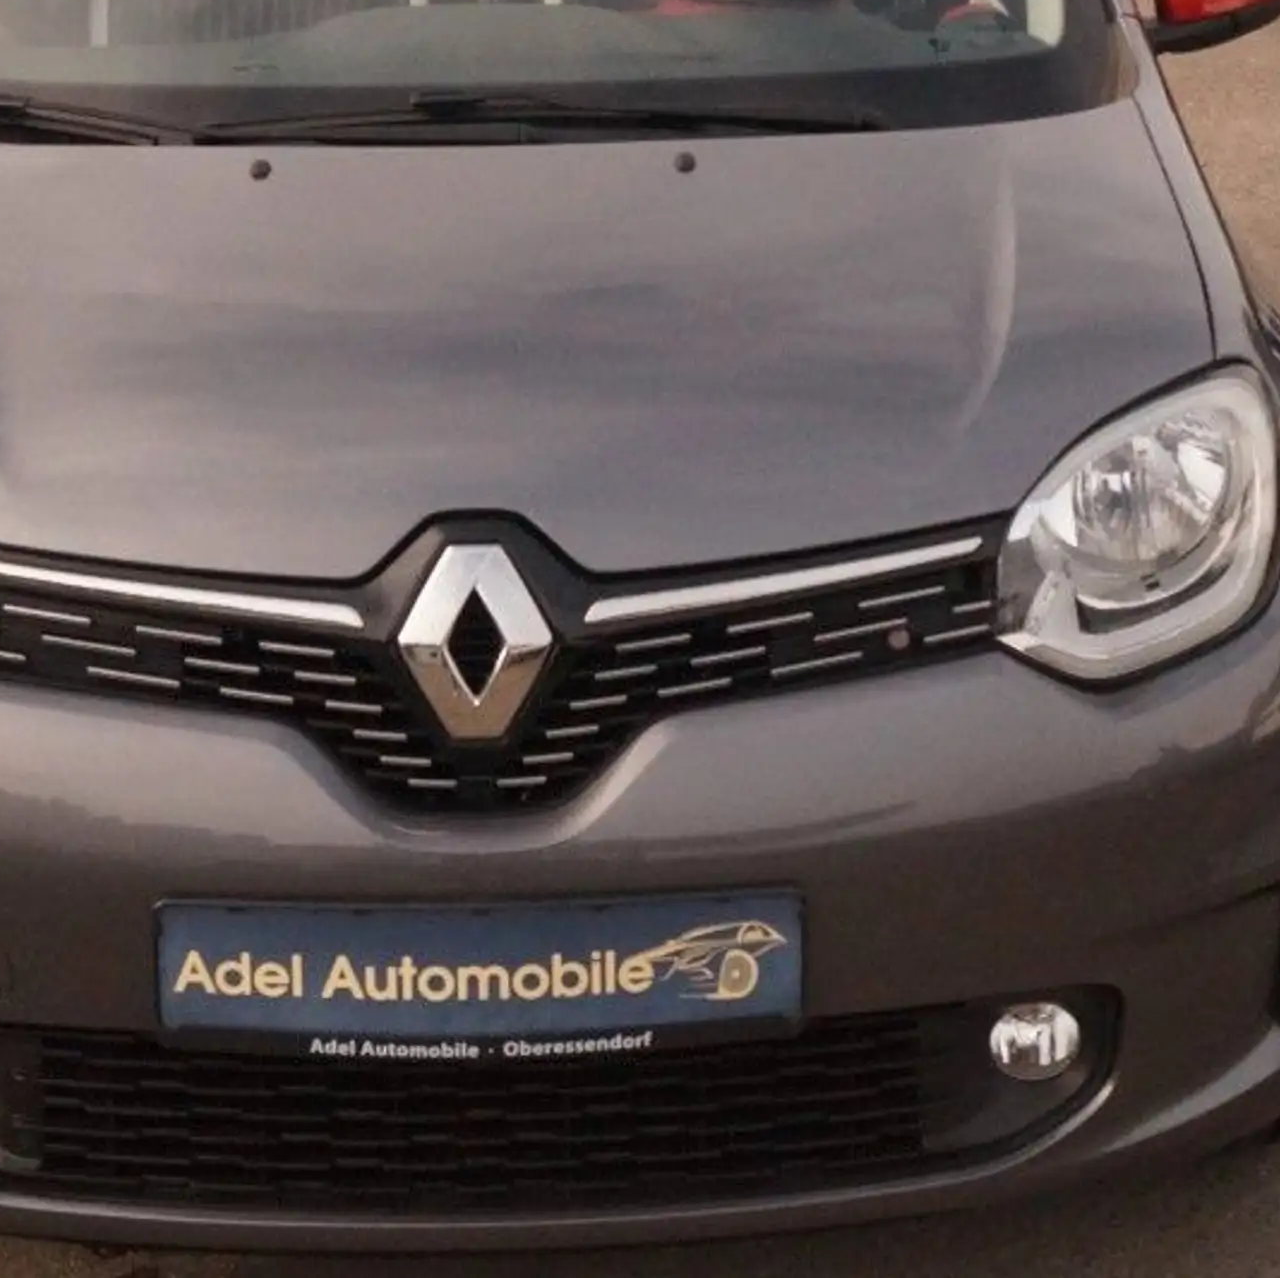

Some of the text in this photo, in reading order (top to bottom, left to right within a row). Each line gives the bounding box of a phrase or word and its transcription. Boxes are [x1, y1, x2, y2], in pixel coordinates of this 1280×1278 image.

[173, 948, 656, 1003] Adel Automobile
[309, 1030, 653, 1060] Adel Automobile Oberessendorf
